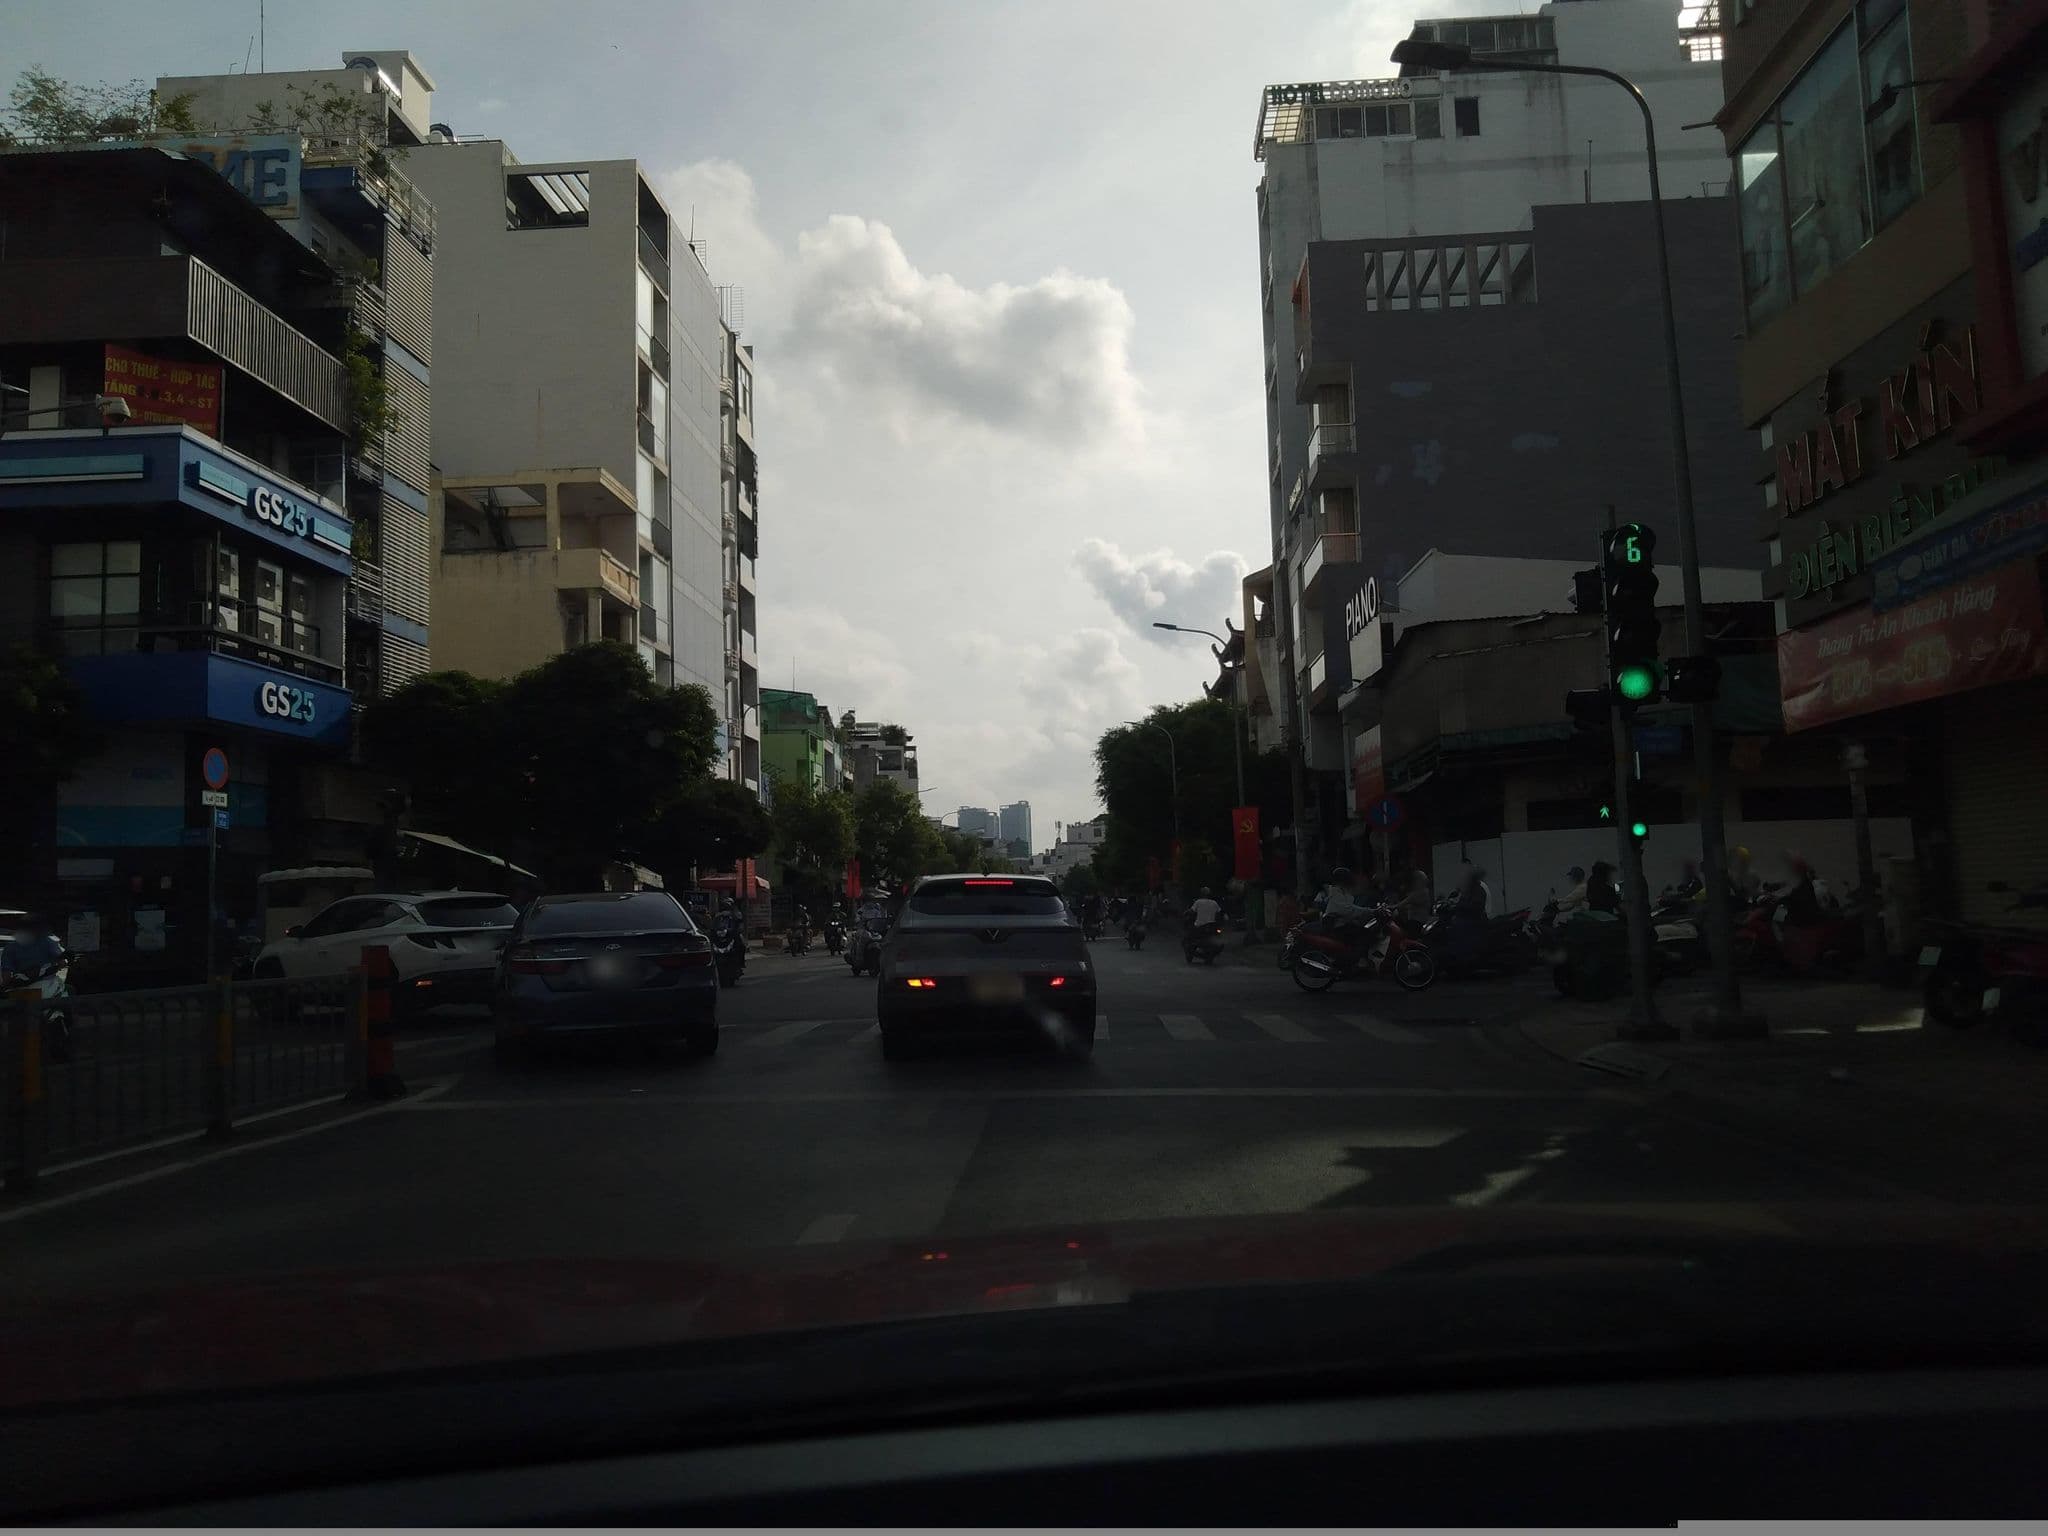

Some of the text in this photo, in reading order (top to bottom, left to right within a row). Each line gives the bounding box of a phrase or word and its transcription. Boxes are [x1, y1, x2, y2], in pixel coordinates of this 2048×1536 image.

[1271, 84, 1325, 104] HOTEL
[254, 486, 308, 537] GS25
[1626, 536, 1641, 563] 6
[1345, 576, 1377, 641] PIANO
[261, 681, 316, 723] GS25
